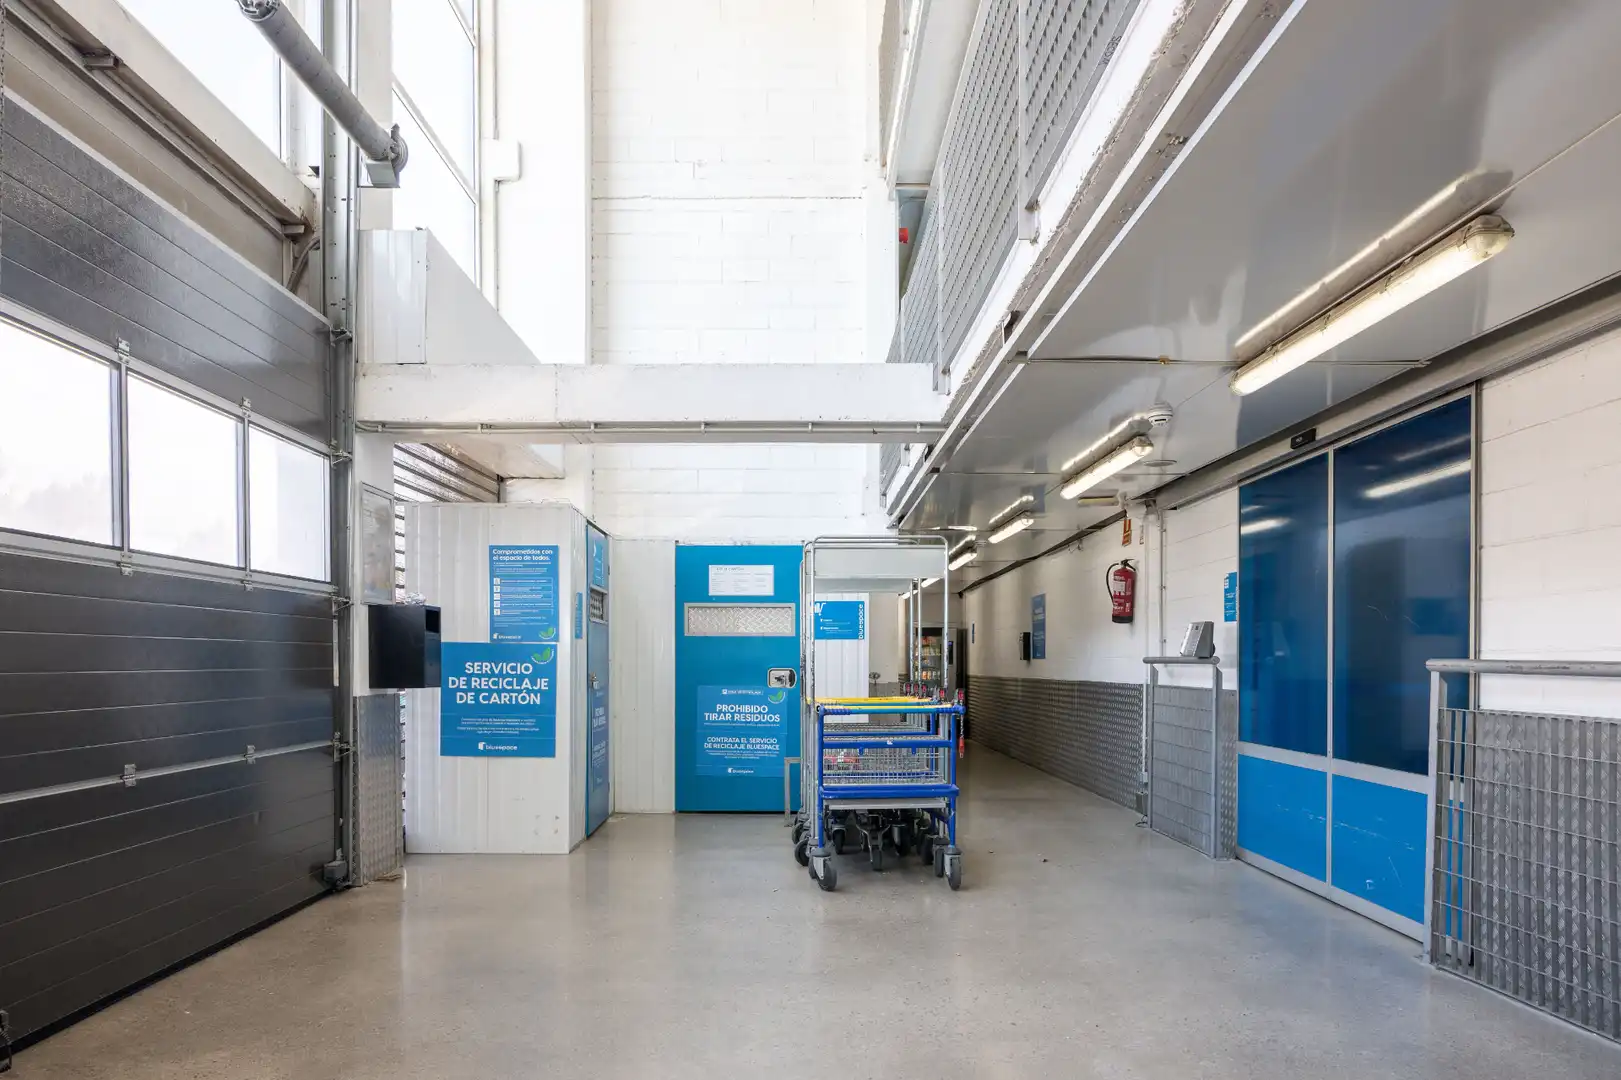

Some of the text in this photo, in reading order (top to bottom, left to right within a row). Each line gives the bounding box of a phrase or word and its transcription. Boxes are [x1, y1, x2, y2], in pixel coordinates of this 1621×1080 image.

[492, 548, 541, 556] Comprometidos
[499, 555, 522, 563] espacio
[464, 662, 533, 675] SERVICIO
[448, 676, 549, 690] DE RECICLAJE
[456, 690, 541, 705] DE CARTÓN
[716, 704, 768, 713] PROHIBIDO
[704, 712, 780, 722] TIRAR RESIDUOS
[485, 743, 518, 753] bluespace
